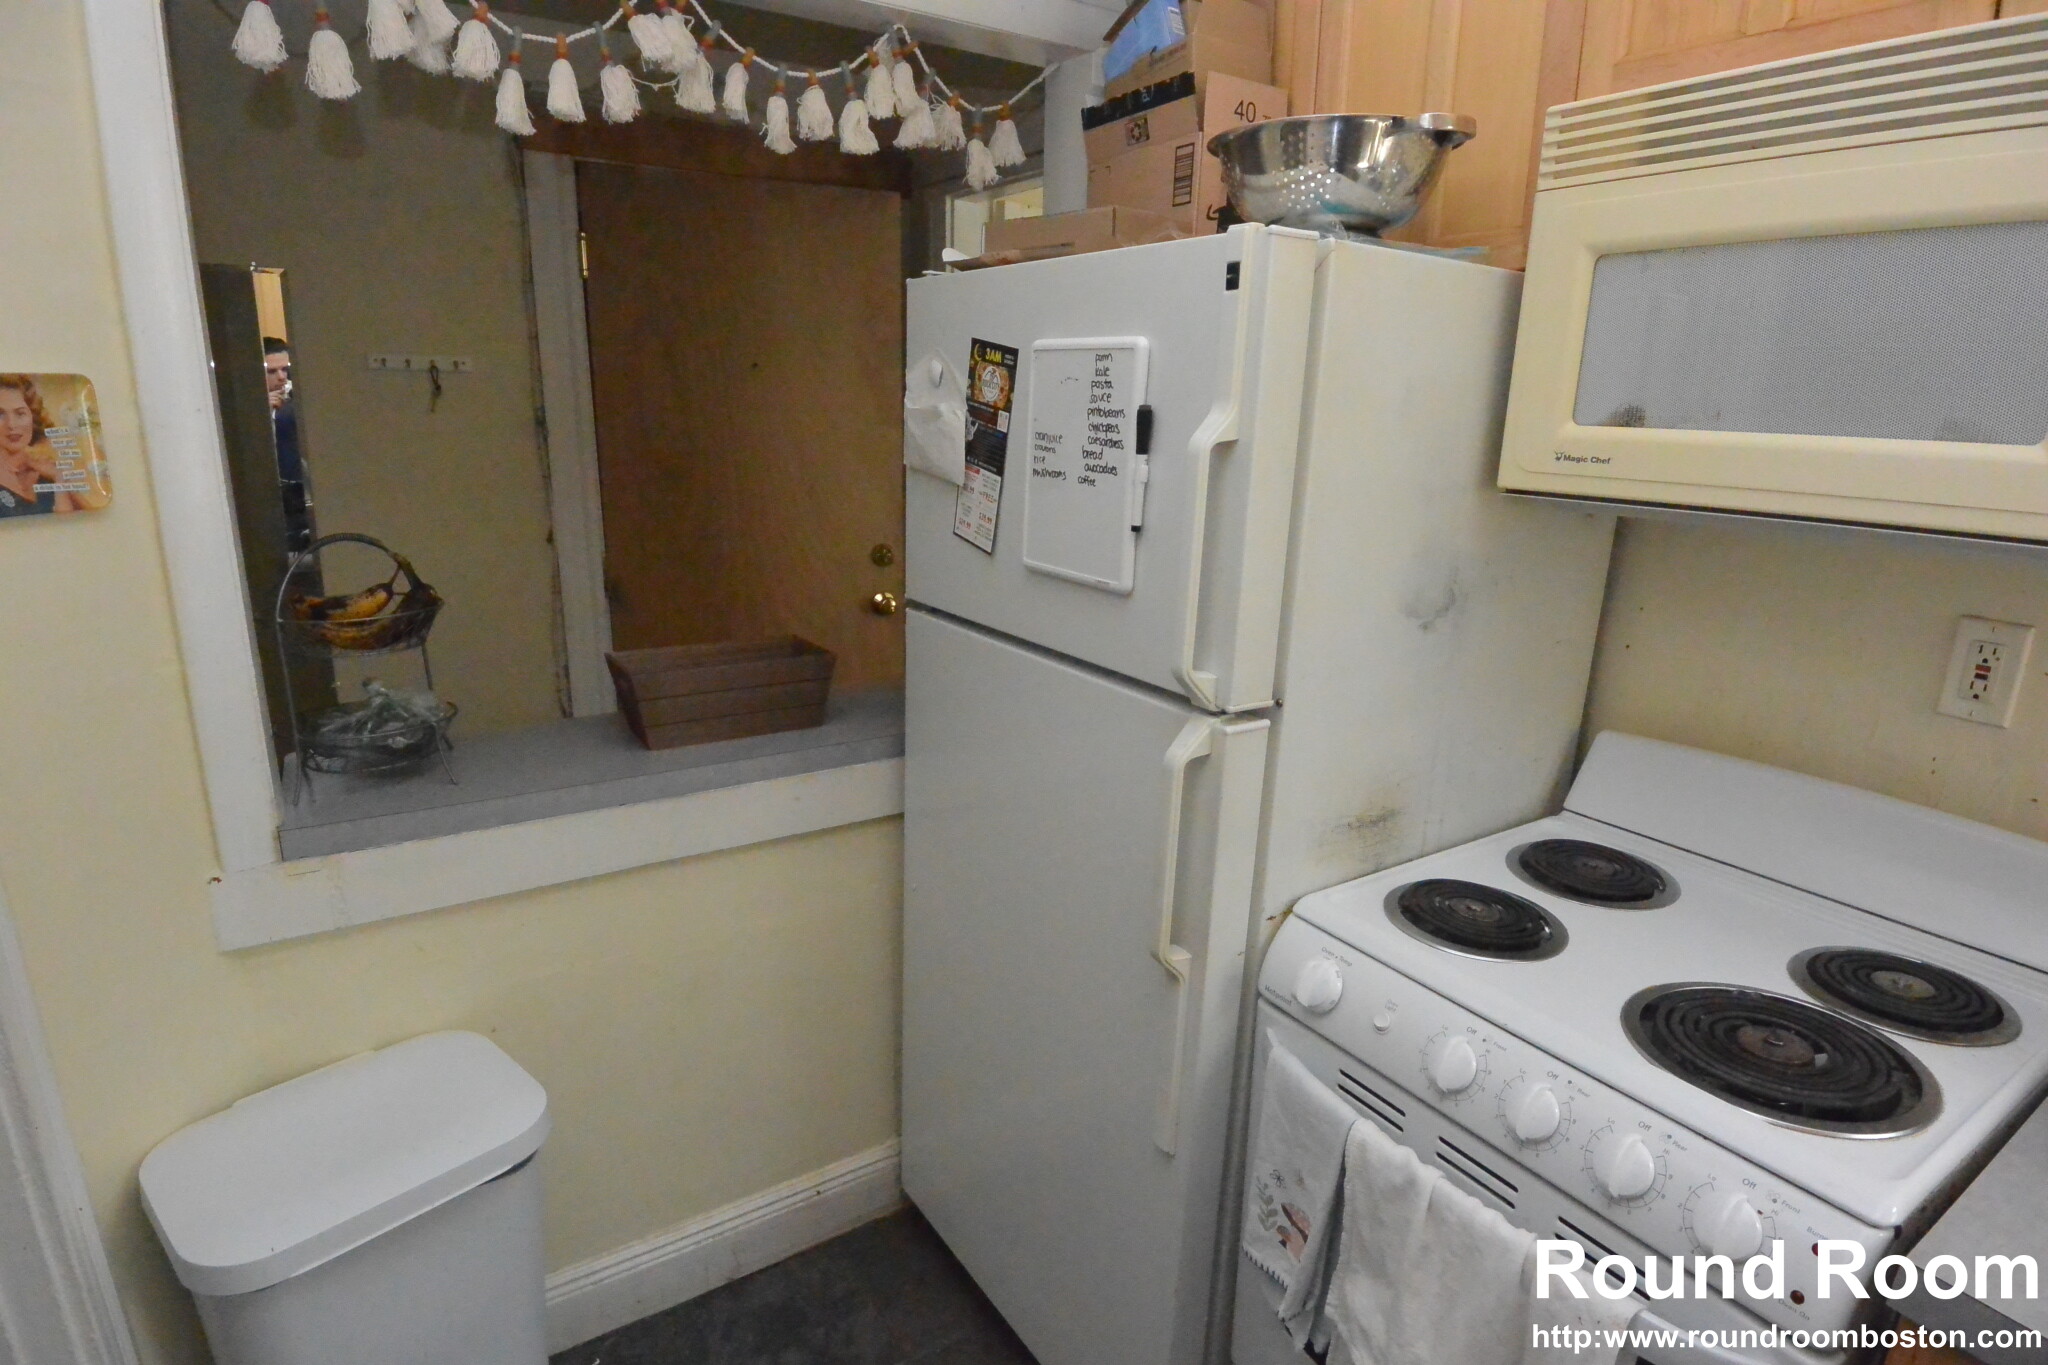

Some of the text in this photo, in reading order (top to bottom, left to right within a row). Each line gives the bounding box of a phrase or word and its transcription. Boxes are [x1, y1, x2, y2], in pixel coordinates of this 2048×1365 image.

[1234, 99, 1257, 123] 40
[985, 347, 1002, 364] 3AM
[1095, 365, 1110, 377] kale
[1091, 378, 1114, 393] pasta
[1089, 392, 1112, 404] sauce
[1081, 444, 1103, 460] bread
[1033, 455, 1046, 465] rice
[1563, 454, 1611, 464] Magic Chef
[1077, 474, 1096, 487] coffee
[1321, 946, 1335, 957] Oven
[1264, 984, 1292, 1006] Hotpoint
[1466, 1026, 1478, 1035] Off
[1546, 1071, 1560, 1080] Off
[1638, 1120, 1652, 1132] Off
[1742, 1178, 1757, 1190] Off
[1781, 1200, 1801, 1214] Front
